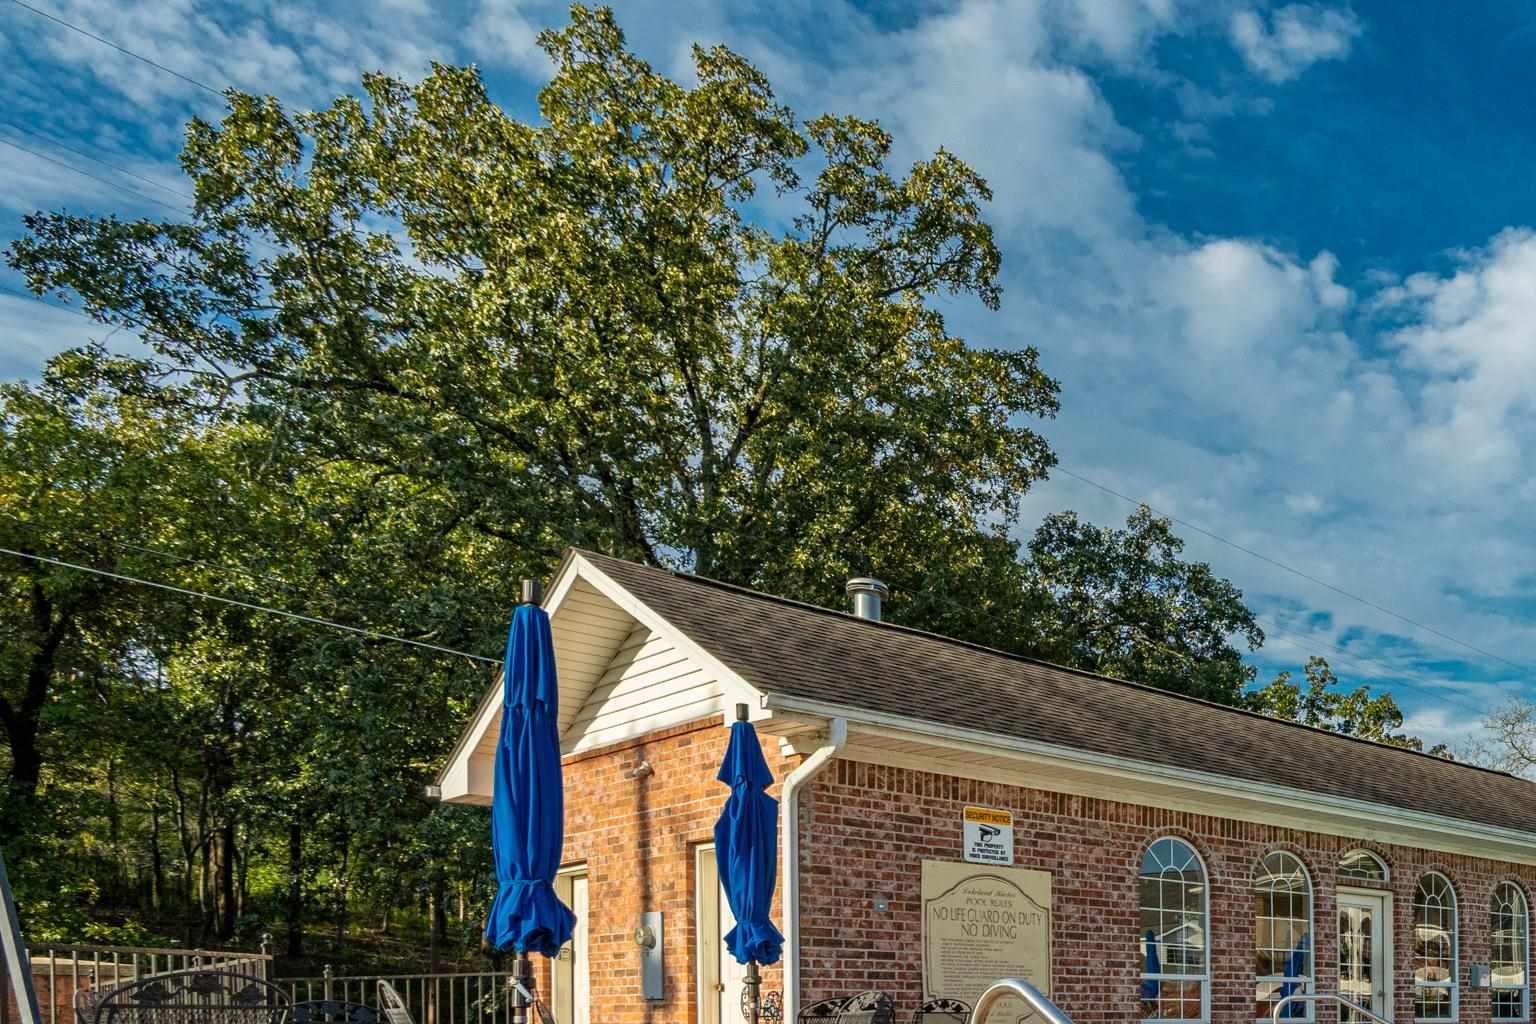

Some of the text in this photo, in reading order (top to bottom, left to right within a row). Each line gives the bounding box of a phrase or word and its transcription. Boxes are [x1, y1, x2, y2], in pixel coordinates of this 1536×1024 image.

[933, 906, 948, 920] NO
[1002, 910, 1016, 924] ON
[1018, 911, 1041, 925] DUTY
[961, 923, 1017, 939] NO DIVING
